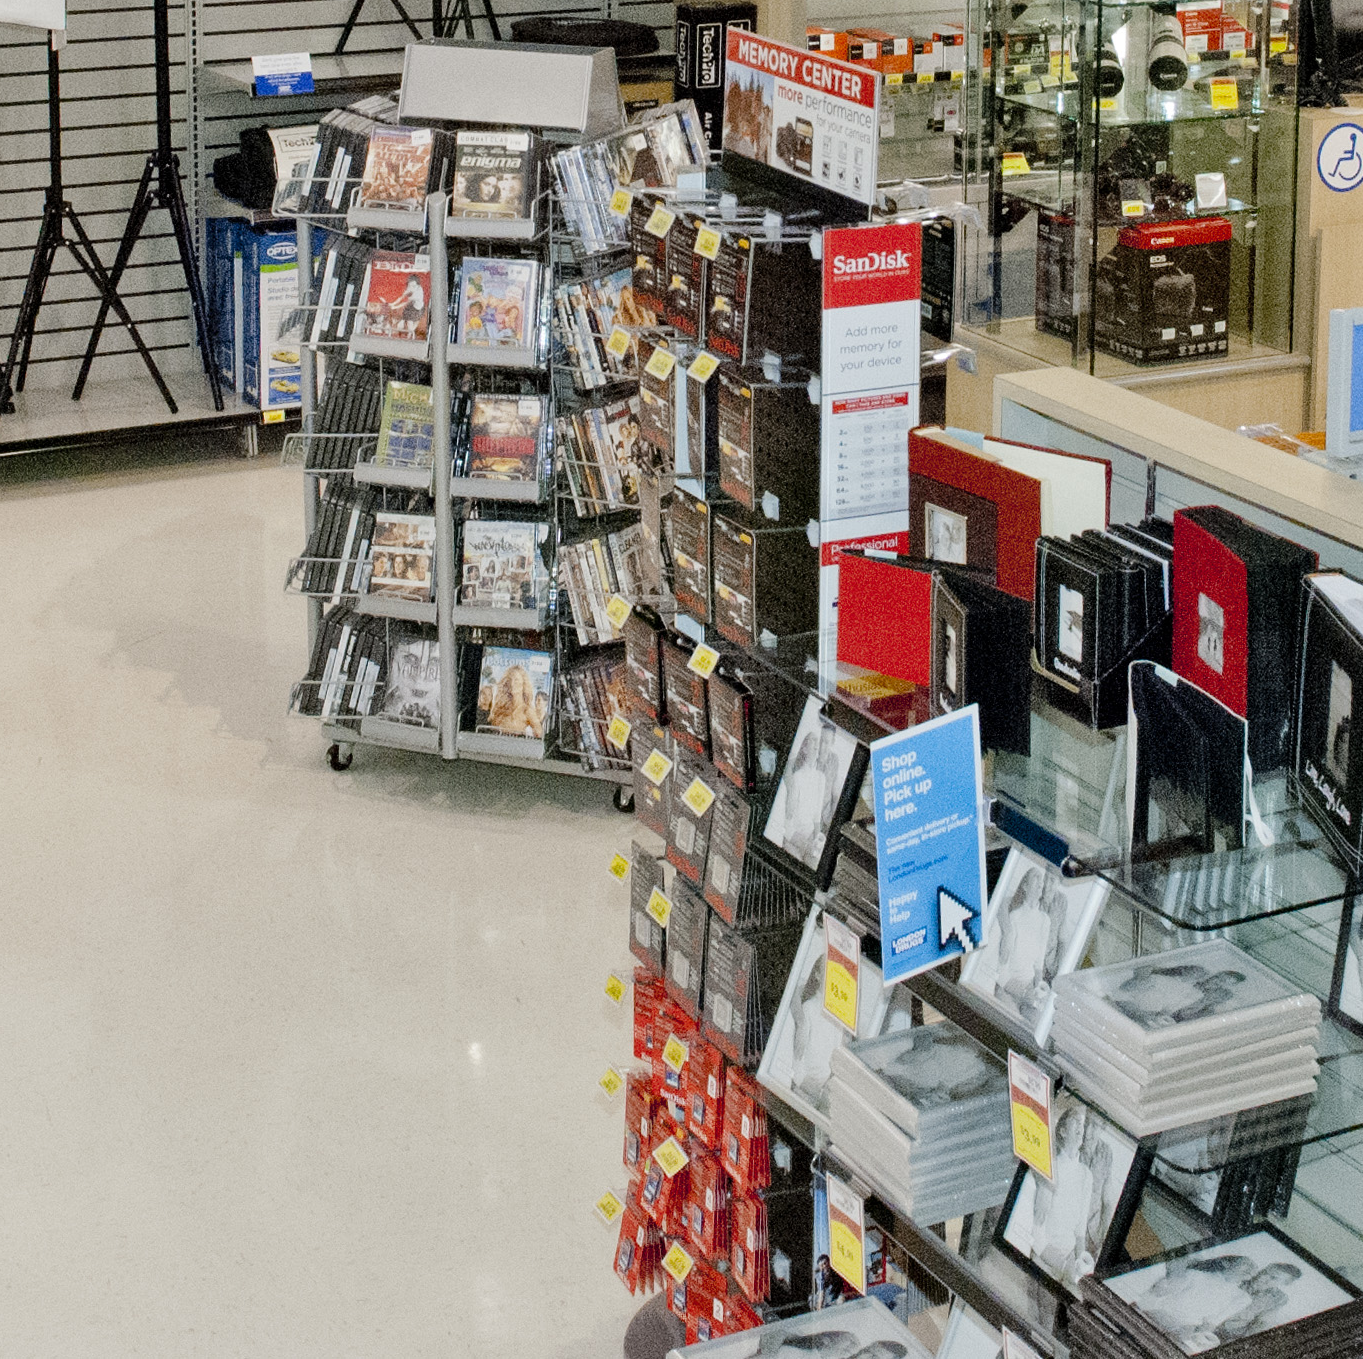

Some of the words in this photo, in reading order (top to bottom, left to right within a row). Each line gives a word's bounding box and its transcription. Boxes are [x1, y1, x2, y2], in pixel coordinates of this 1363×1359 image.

[699, 26, 717, 86] TechPro
[739, 39, 798, 78] MEMORY
[801, 61, 862, 100] CENTER
[777, 83, 804, 106] more
[804, 93, 872, 130] performance
[815, 115, 826, 127] for
[827, 119, 844, 136] your
[844, 126, 872, 144] camera
[460, 153, 522, 169] enigma
[833, 250, 911, 275] SanDisk
[845, 326, 867, 338] Add
[871, 324, 899, 335] more
[839, 342, 884, 355] memory
[887, 338, 902, 349] for
[840, 359, 864, 372] your
[867, 353, 902, 368] device
[881, 750, 917, 773] Shop
[882, 764, 927, 790] online.
[884, 786, 913, 806] Pick
[914, 778, 933, 795] up
[885, 802, 918, 822] here.
[892, 928, 926, 948] LONDON
[894, 937, 924, 955] DRUGS
